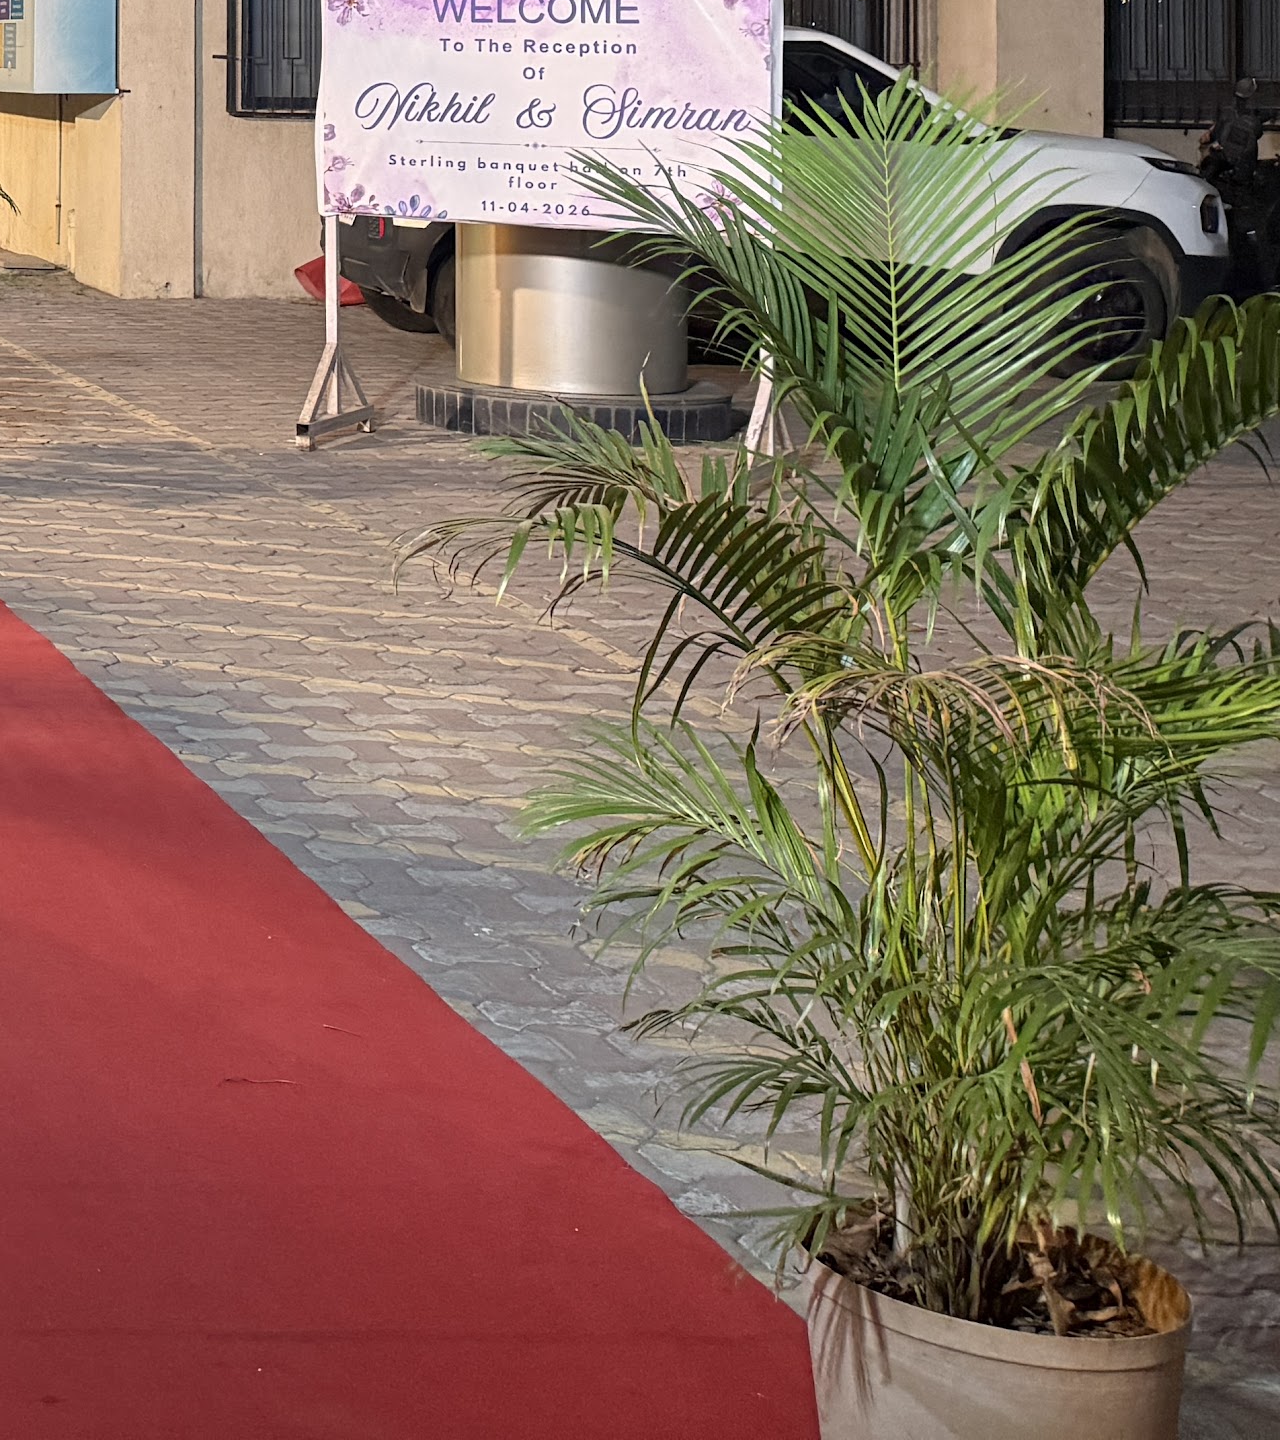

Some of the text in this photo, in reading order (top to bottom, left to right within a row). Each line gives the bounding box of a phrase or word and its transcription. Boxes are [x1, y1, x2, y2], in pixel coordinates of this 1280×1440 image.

[440, 38, 638, 57] To The Reception
[522, 66, 545, 80] Of
[354, 82, 752, 139] Nikhil & Simran
[389, 154, 467, 171] Sterling
[477, 157, 559, 174] banquet
[620, 167, 641, 176] on
[654, 164, 687, 177] 7th
[508, 177, 558, 190] floor
[481, 200, 591, 217] 11-04-2026
